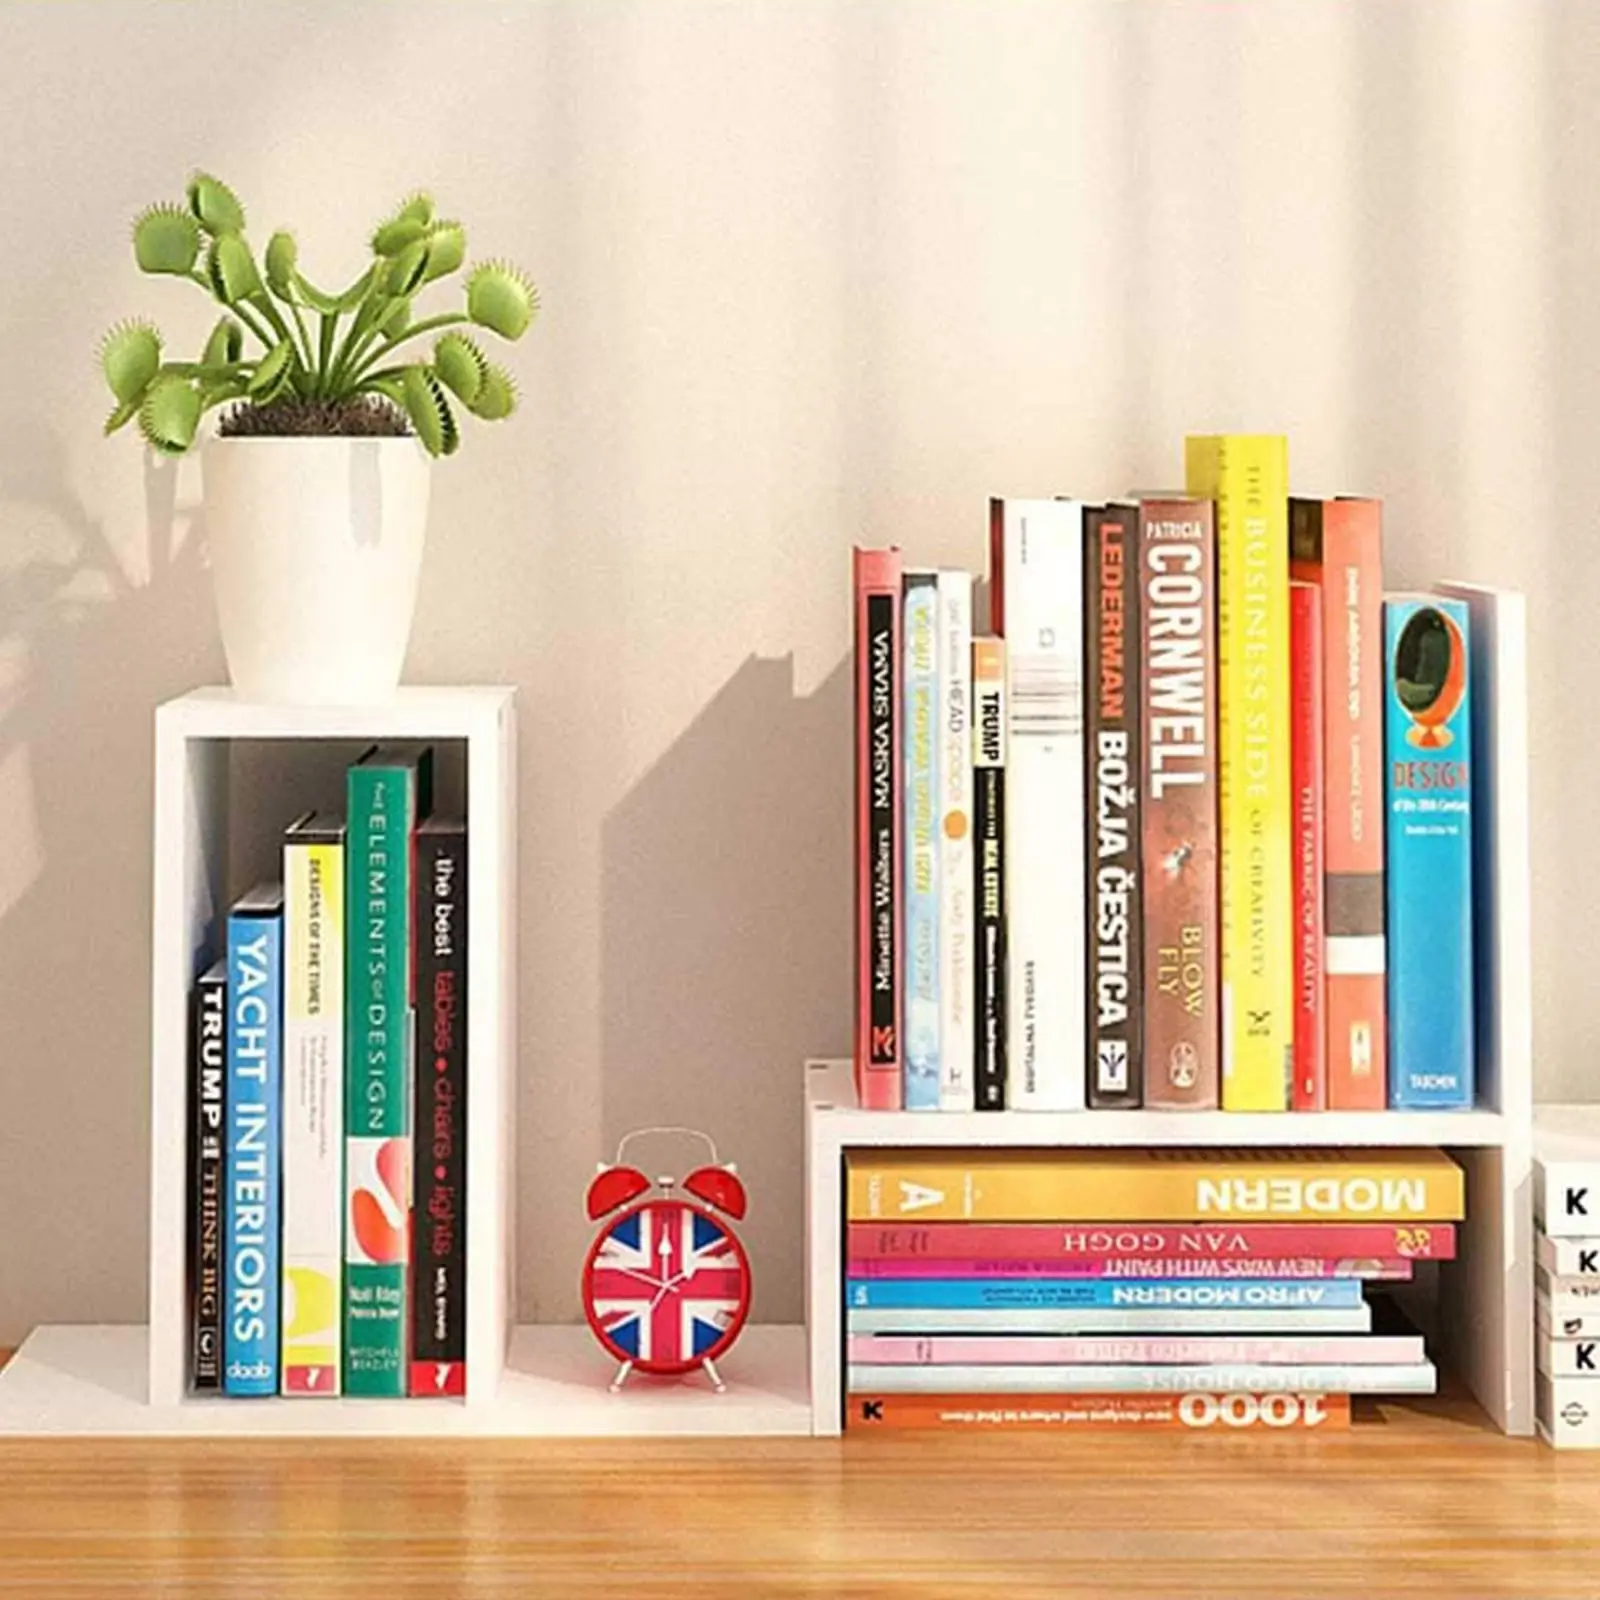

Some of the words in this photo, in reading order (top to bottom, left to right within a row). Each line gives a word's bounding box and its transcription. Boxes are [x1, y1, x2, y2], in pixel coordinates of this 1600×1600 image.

[1099, 523, 1124, 718] LEDERMAN
[1244, 517, 1269, 701] BUSINESS
[873, 630, 890, 716] SRAMA
[1148, 544, 1204, 799] CORNWELL
[982, 692, 1000, 761] TRUMP
[1244, 712, 1270, 800] SIDE
[873, 723, 889, 808] MASKA
[1097, 731, 1136, 856] BOŽJA
[368, 815, 385, 976] ELEMENTS
[435, 858, 453, 895] the
[874, 829, 891, 906] Walters
[307, 922, 321, 938] OF
[435, 904, 454, 957] best
[875, 912, 891, 991] Minette
[1097, 865, 1136, 1027] ČESTICA
[1158, 947, 1180, 996] FLY
[1181, 925, 1204, 1017] BLOW
[236, 936, 268, 1083] YACHT
[435, 971, 454, 1052] tables
[202, 988, 222, 1127] TRUMP
[367, 1003, 386, 1129] DESIGN
[433, 1078, 455, 1159] chairs
[202, 1171, 218, 1259] THINK
[233, 1103, 267, 1342] INTERIORS
[428, 1186, 455, 1255] lights
[899, 1180, 946, 1213] A
[1196, 1179, 1426, 1212] MODERN
[1566, 1188, 1588, 1216] K
[1062, 1233, 1165, 1252] GOGH
[1102, 1259, 1163, 1277] PAINT
[1164, 1258, 1219, 1277] WITH
[1180, 1232, 1250, 1251] VAN
[1223, 1258, 1274, 1277] WAYS
[1275, 1258, 1324, 1277] NEW
[1579, 1250, 1598, 1273] K
[202, 1268, 218, 1317] BIG
[1112, 1286, 1240, 1305] MODERN
[1246, 1286, 1325, 1304] AFRO
[1576, 1344, 1596, 1370] K
[1178, 1393, 1328, 1427] 1000
